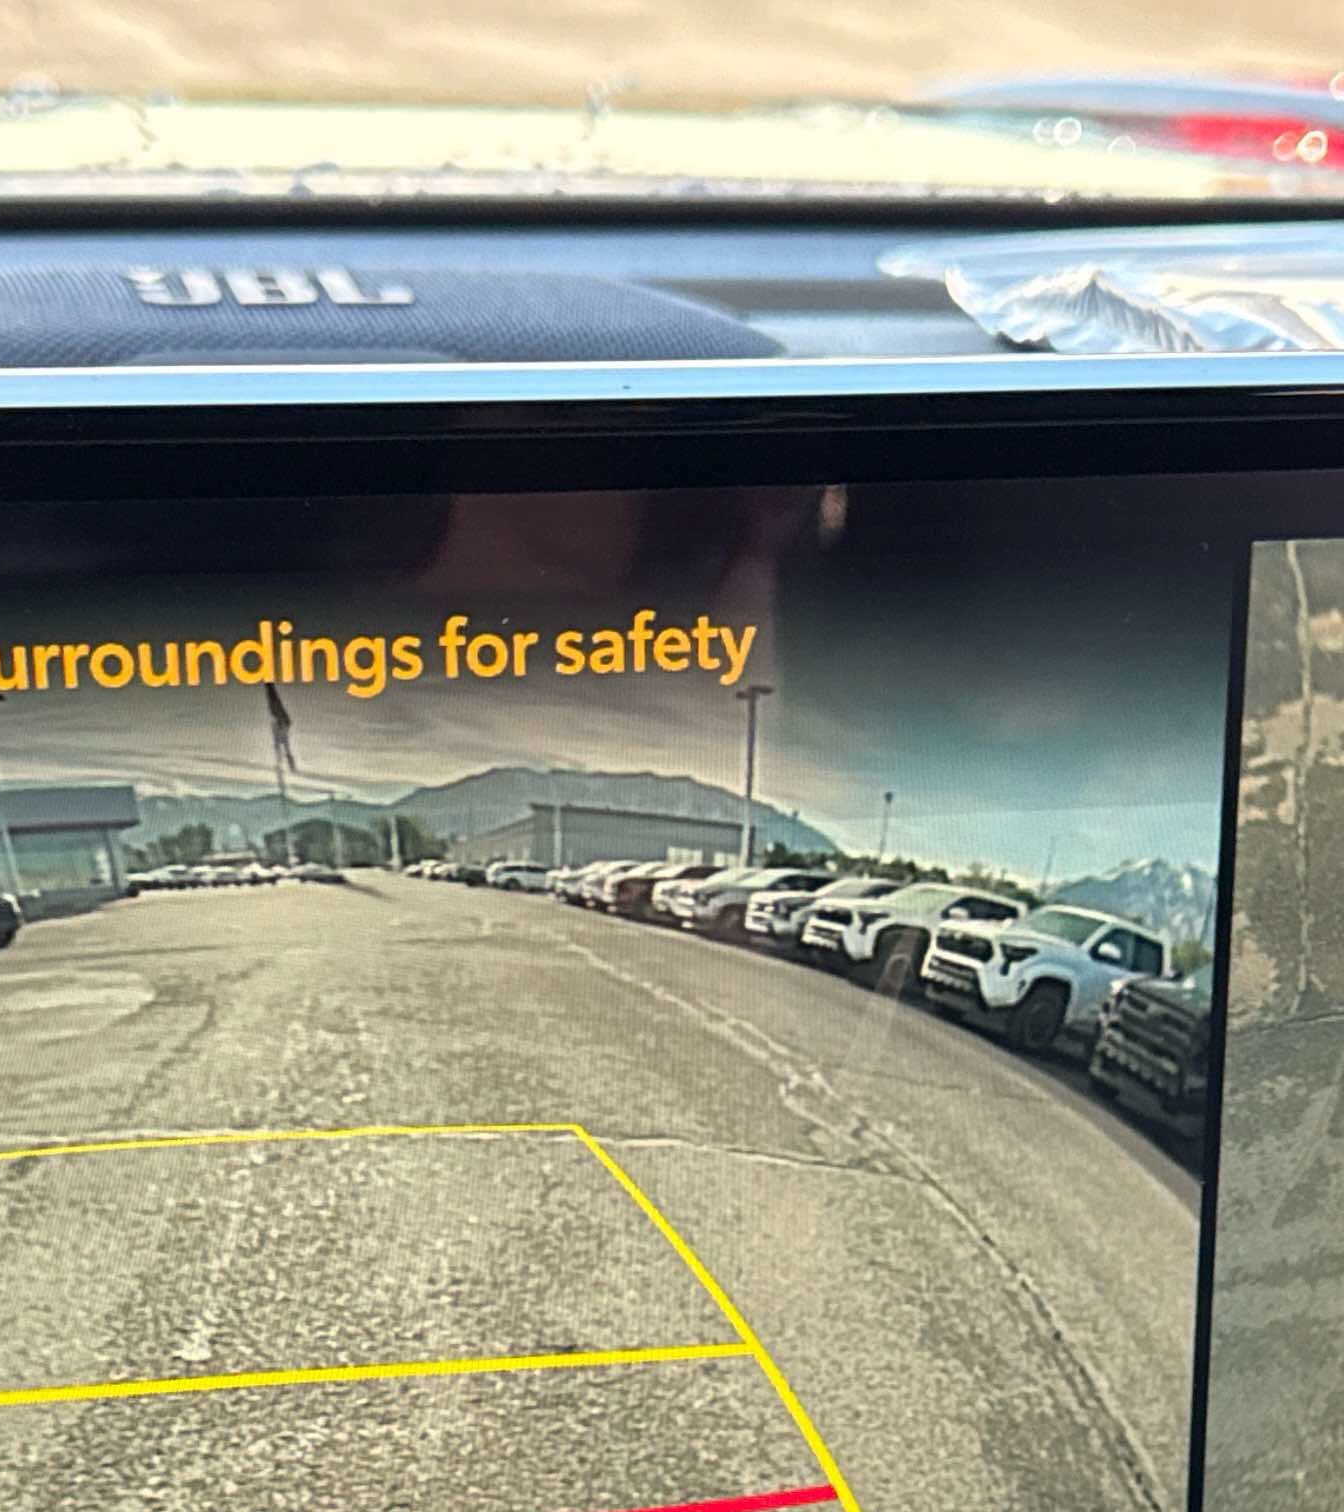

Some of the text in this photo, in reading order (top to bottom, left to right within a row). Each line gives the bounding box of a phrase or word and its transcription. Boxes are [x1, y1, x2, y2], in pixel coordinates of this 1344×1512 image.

[121, 263, 415, 305] JBL
[439, 614, 540, 679] for
[555, 609, 757, 686] safety
